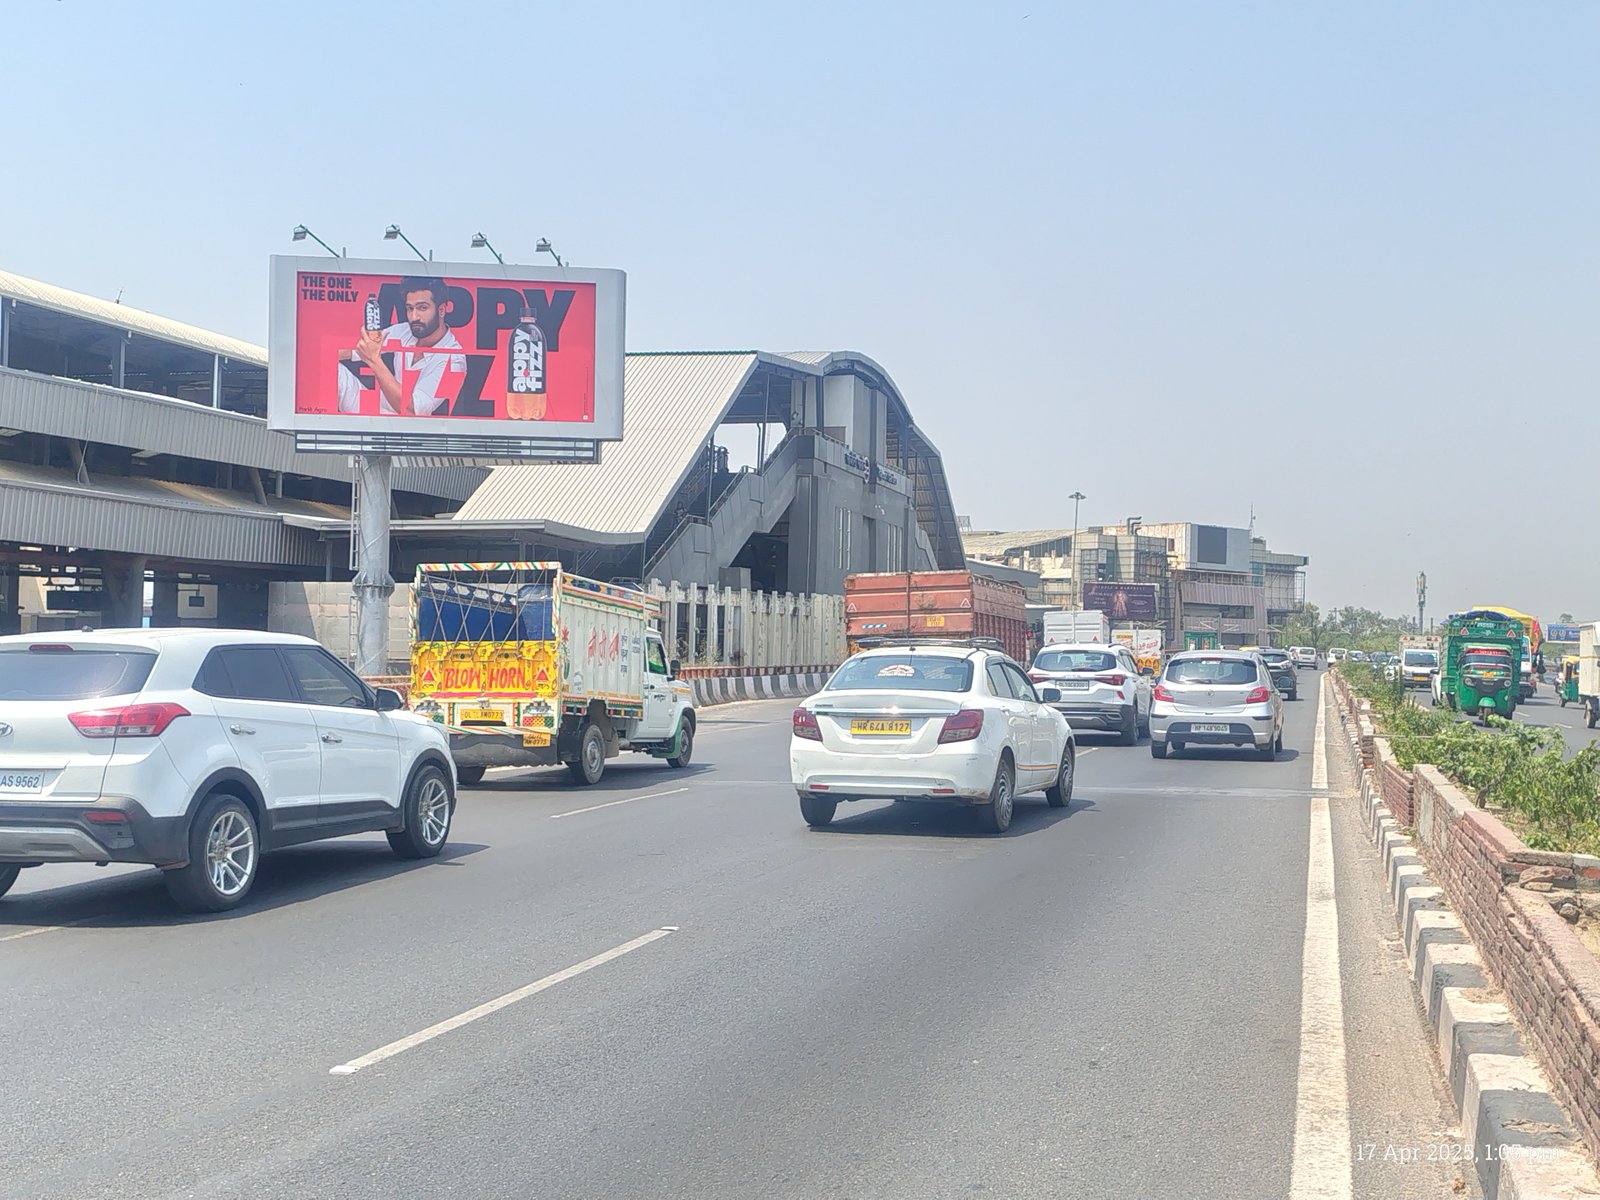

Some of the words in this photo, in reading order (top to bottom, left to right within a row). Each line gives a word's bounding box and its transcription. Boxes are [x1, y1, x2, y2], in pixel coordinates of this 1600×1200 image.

[302, 275, 325, 288] THE
[327, 276, 352, 289] ONE
[302, 288, 325, 301] THE
[327, 290, 359, 302] ONLY
[513, 328, 530, 392] appy
[526, 341, 543, 392] fizz
[444, 667, 481, 689] BLOW
[488, 667, 526, 689] HORN
[888, 722, 910, 732] 8127
[15, 775, 40, 788] 9562
